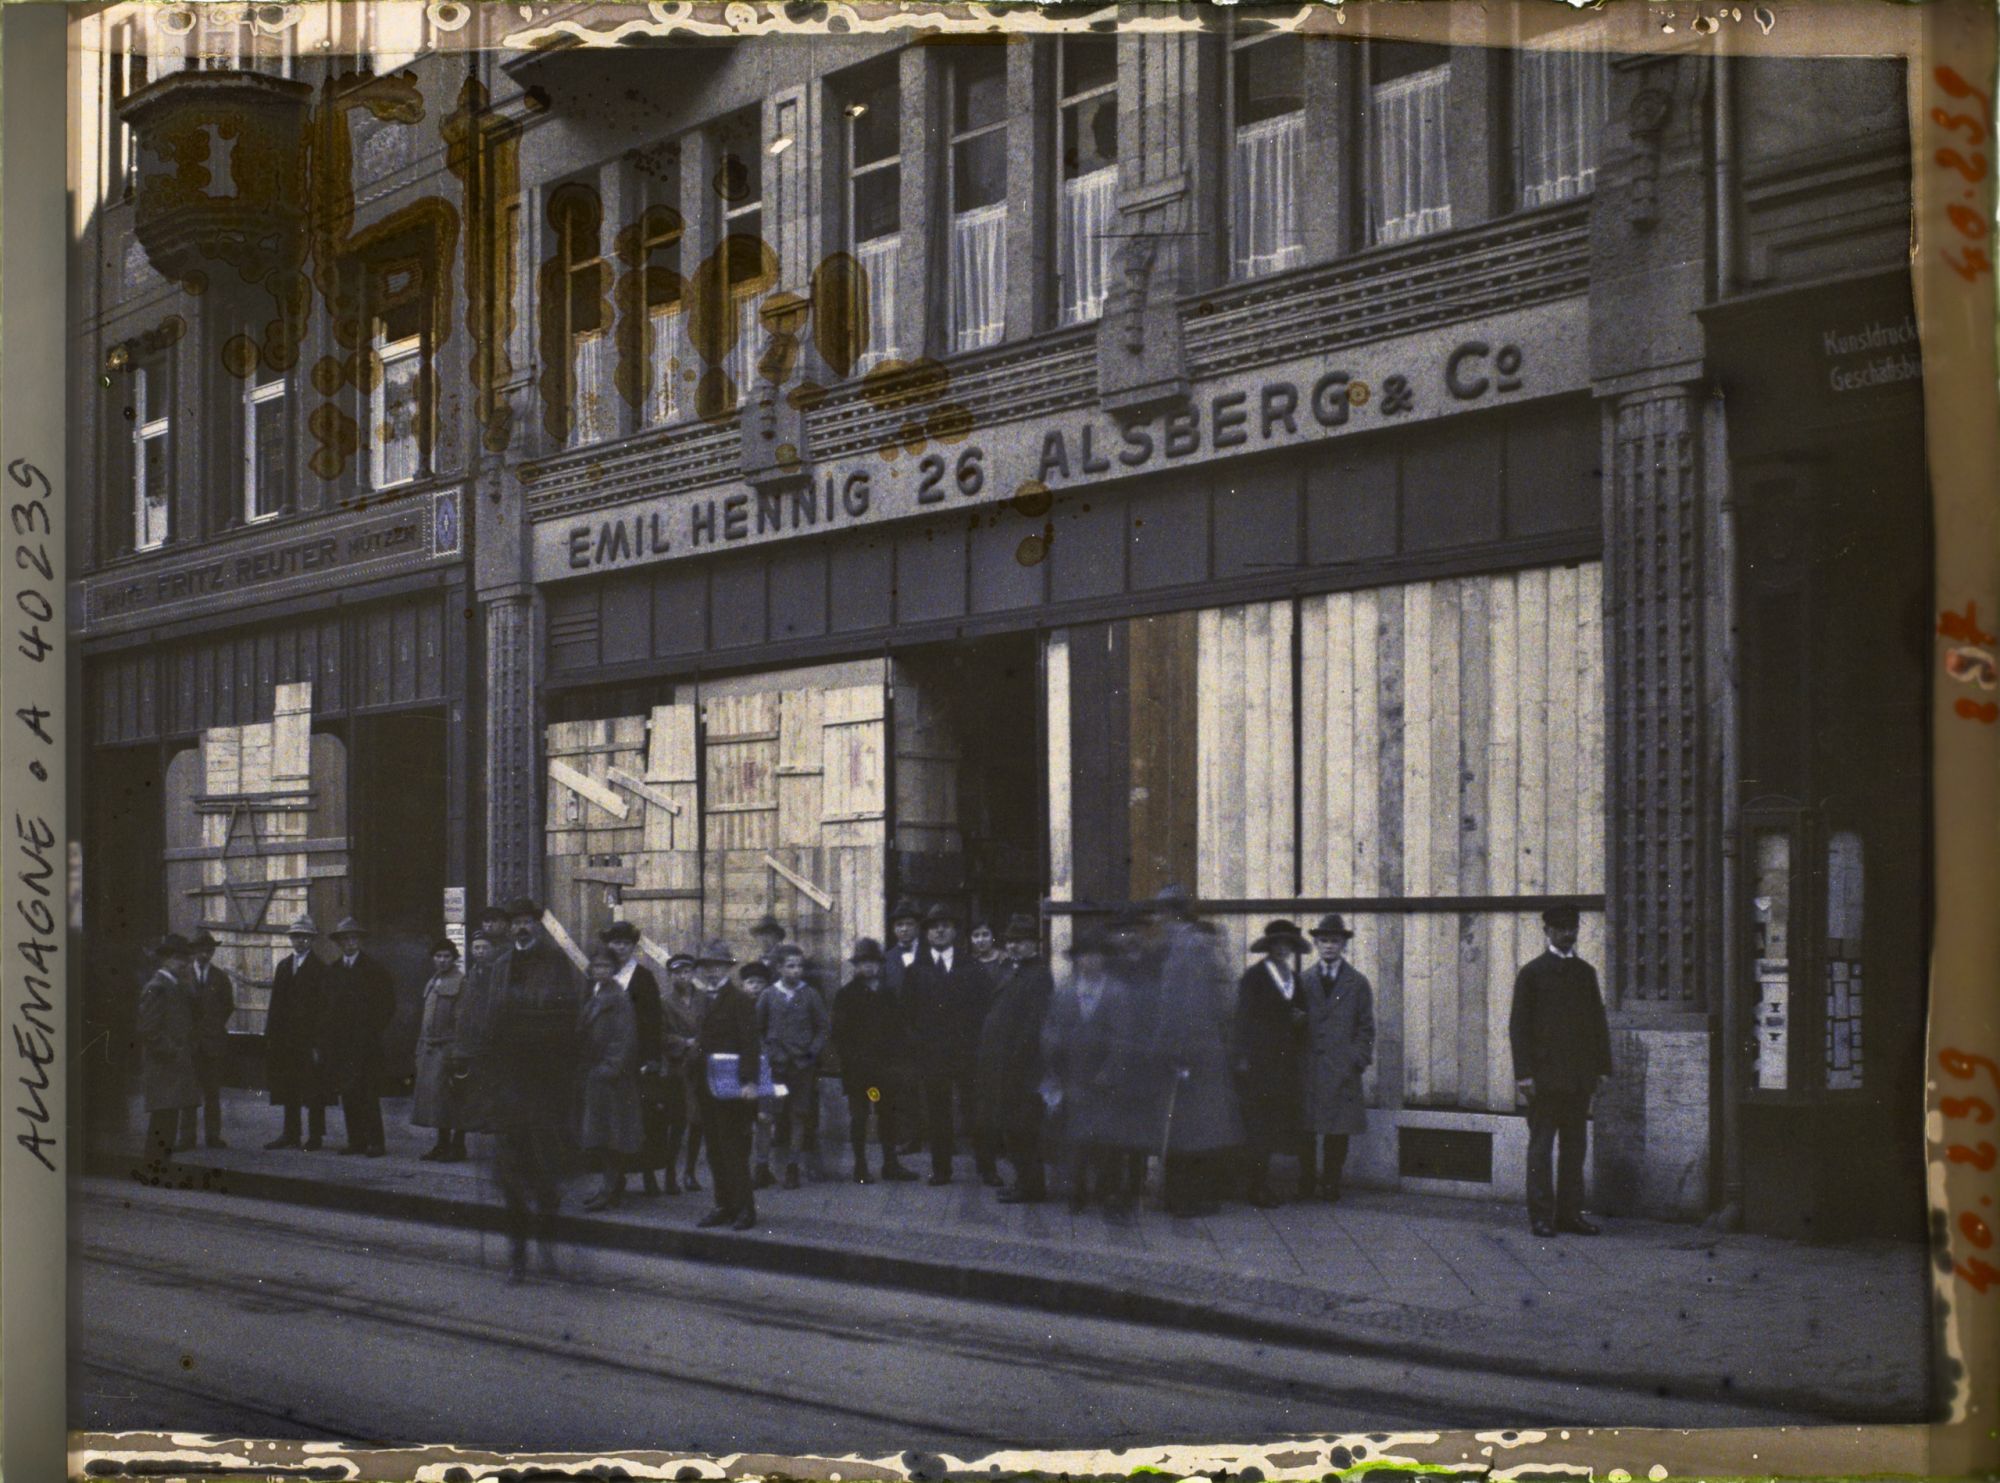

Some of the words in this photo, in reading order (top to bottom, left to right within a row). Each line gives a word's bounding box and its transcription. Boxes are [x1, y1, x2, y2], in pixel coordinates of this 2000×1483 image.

[567, 511, 671, 570] EMIL
[690, 469, 872, 547] HENNIG
[917, 445, 985, 505] 26
[1037, 370, 1352, 483] ALSBERG
[1381, 374, 1416, 416] &
[157, 562, 224, 601] FRITZ
[235, 535, 338, 583] REUTER
[16, 701, 53, 745] A
[13, 808, 59, 1173] ALLEMAGNE
